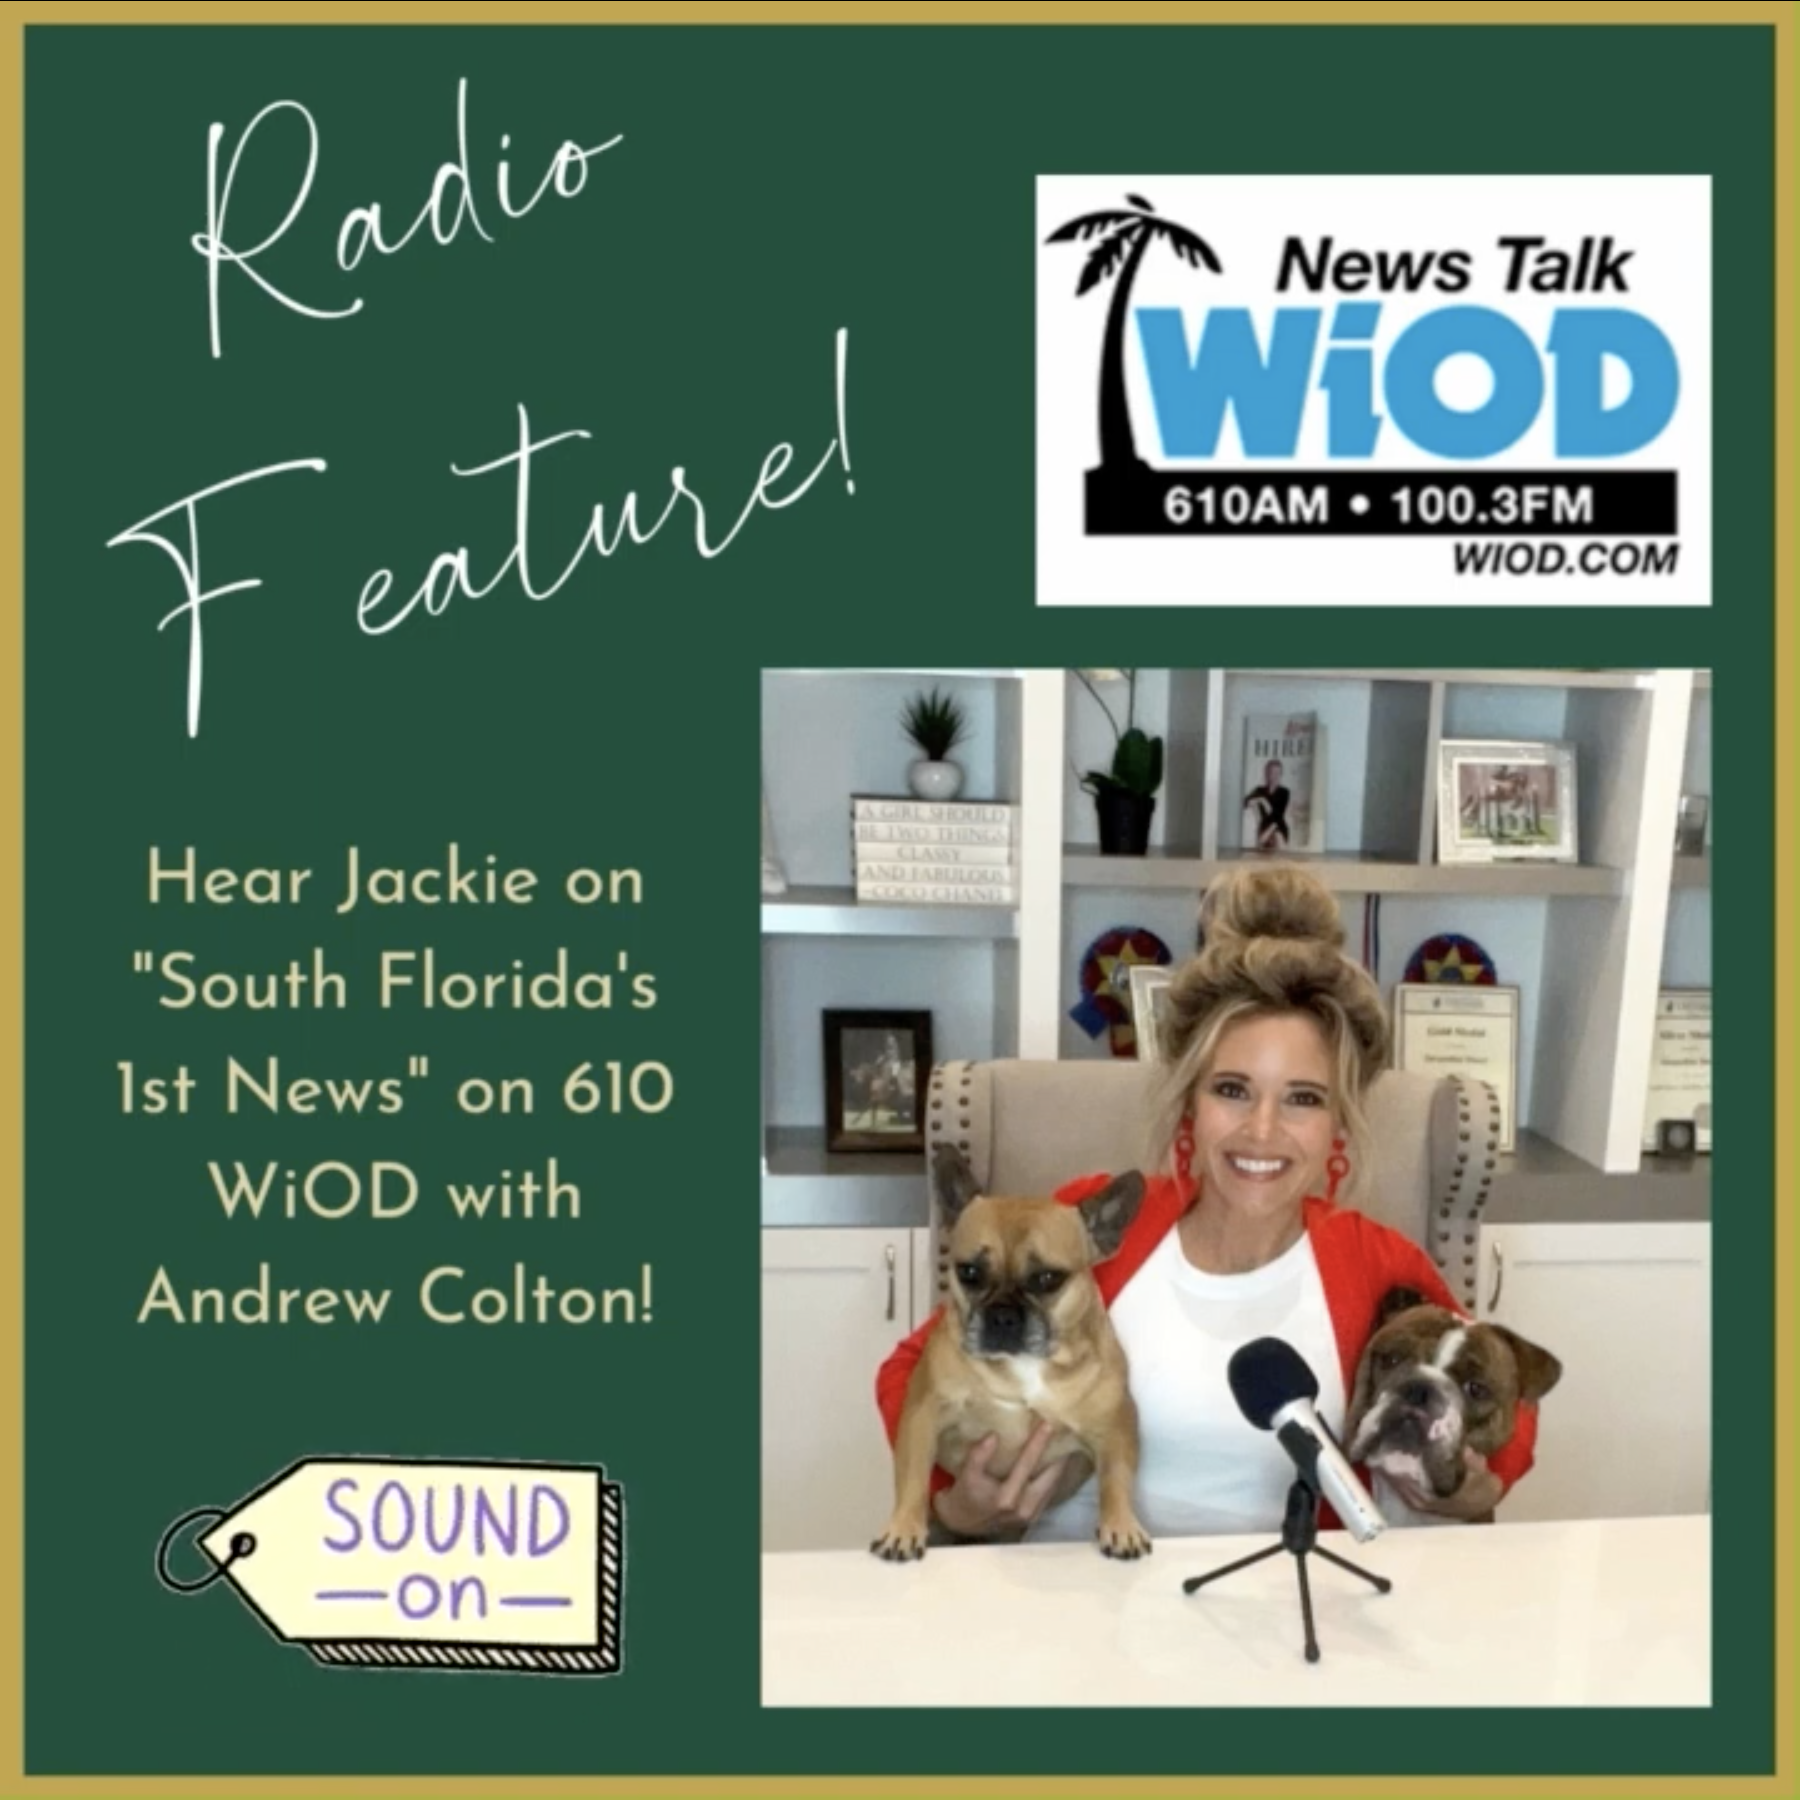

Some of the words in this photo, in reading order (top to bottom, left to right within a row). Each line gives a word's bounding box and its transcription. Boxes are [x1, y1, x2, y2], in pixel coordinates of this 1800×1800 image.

[880, 804, 923, 820] GIRL
[929, 806, 1006, 822] SHOULD
[888, 826, 930, 840] TWO
[938, 827, 1005, 842] THINGS
[896, 846, 961, 861] CLASSY
[863, 864, 906, 880] AND
